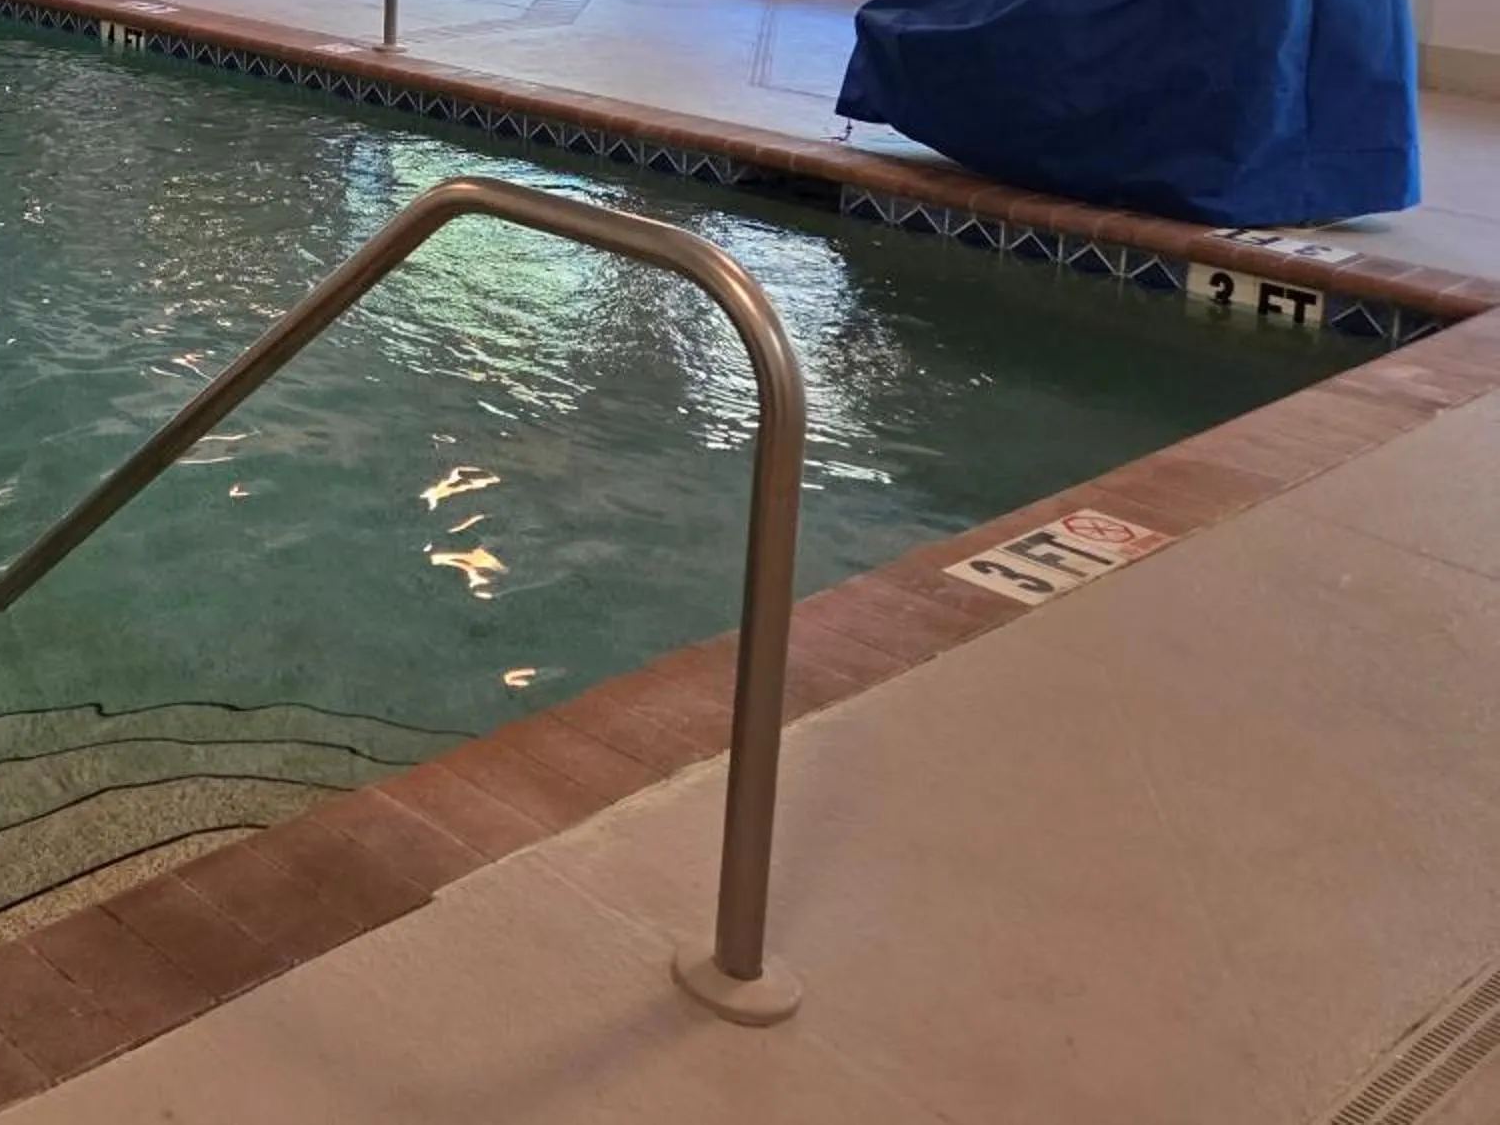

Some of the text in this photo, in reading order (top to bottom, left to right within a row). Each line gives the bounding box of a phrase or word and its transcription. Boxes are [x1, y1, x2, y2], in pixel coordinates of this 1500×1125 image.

[1208, 272, 1318, 323] 3 FT
[968, 559, 1055, 594] 3
[1003, 531, 1114, 578] FT
